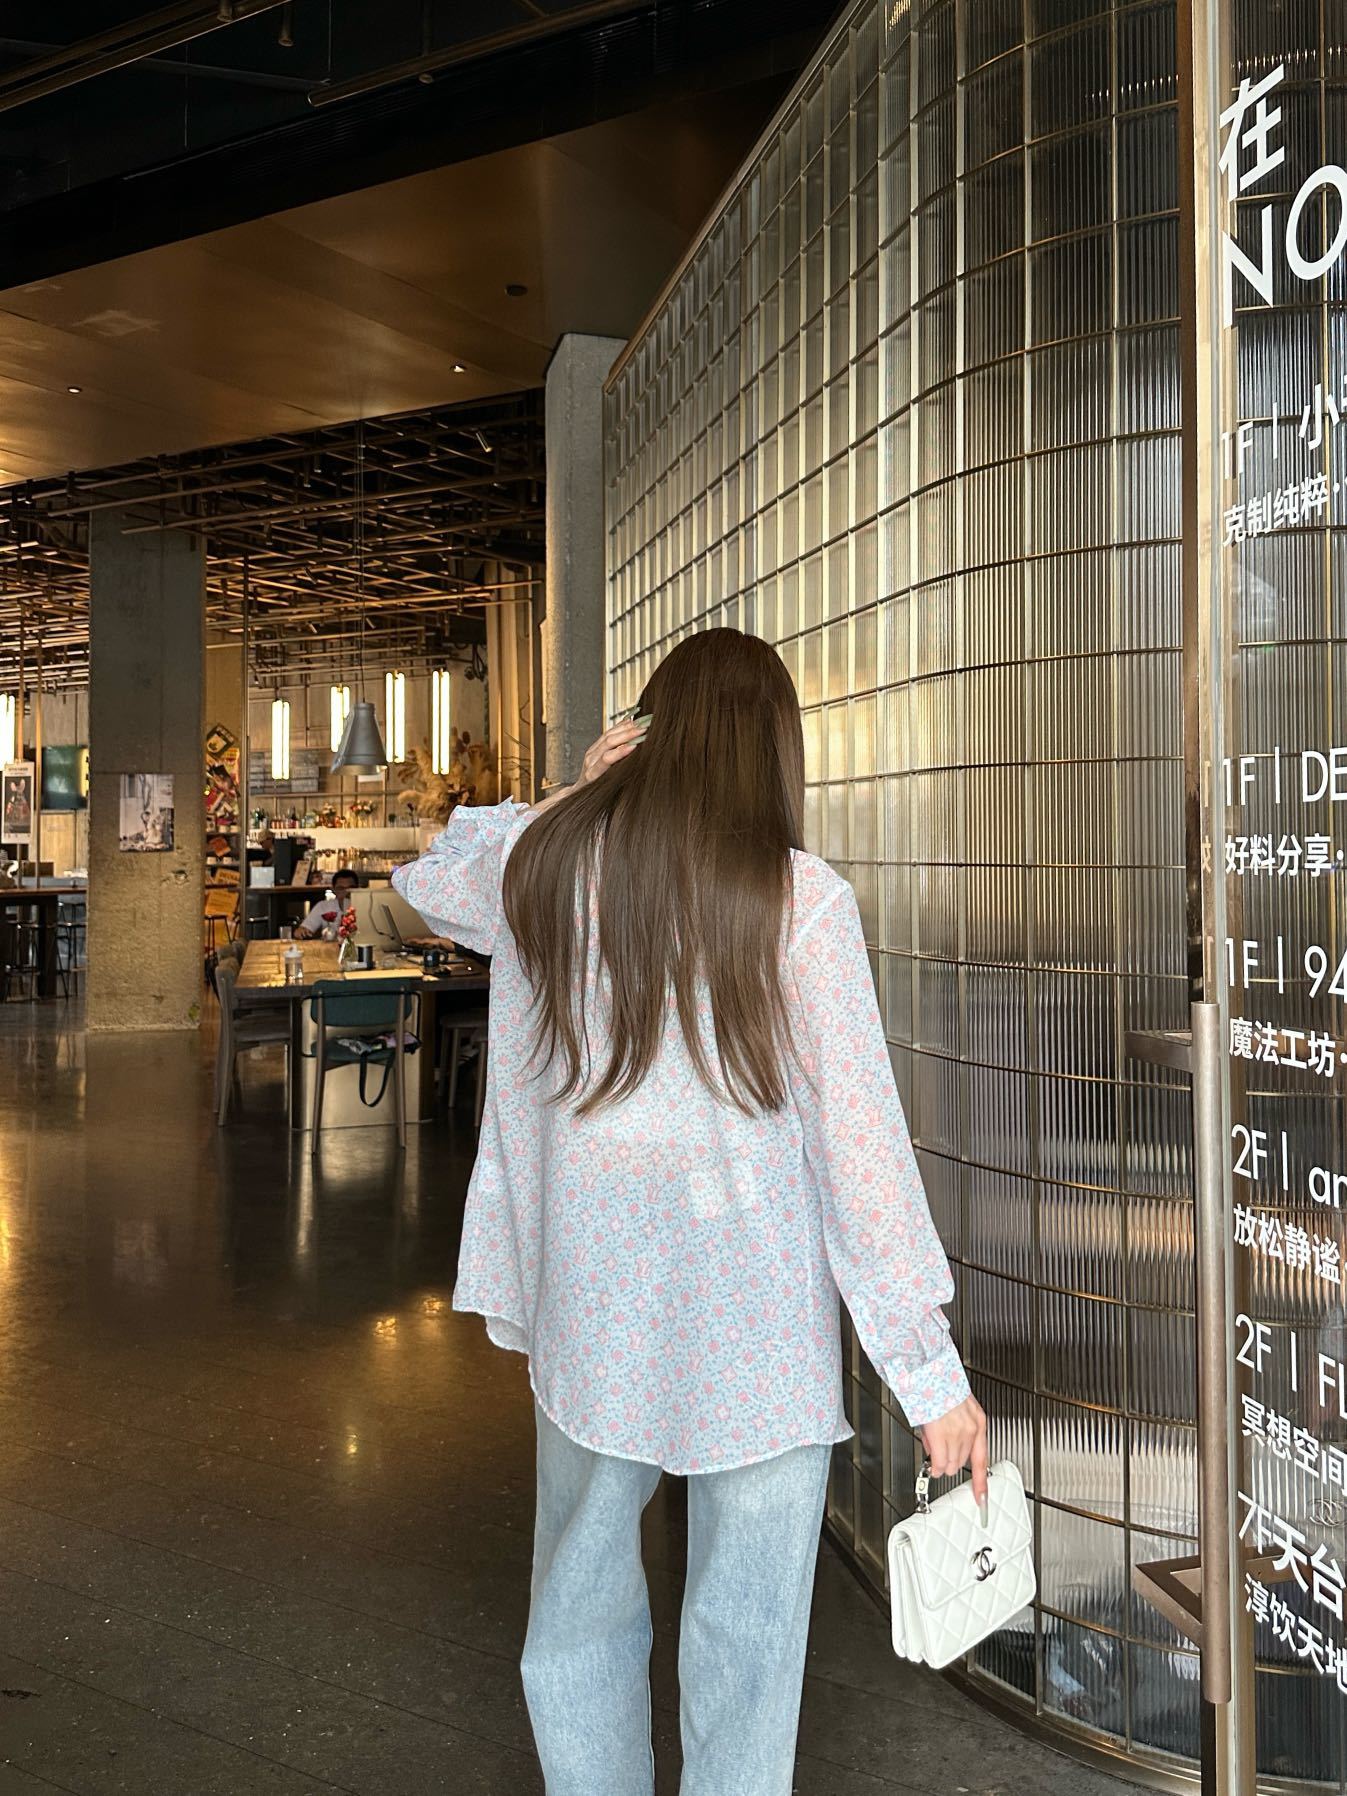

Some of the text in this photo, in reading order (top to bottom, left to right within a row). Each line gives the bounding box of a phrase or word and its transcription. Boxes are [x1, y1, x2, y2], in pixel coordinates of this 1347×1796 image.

[1218, 64, 1285, 202] 在
[1222, 421, 1254, 480] 1F
[1298, 375, 1347, 450] 小
[1223, 757, 1255, 807] 1F
[1225, 937, 1259, 989] 1F
[1231, 1124, 1268, 1181] 2F
[1235, 1313, 1272, 1374] 2F
[1241, 1393, 1347, 1497] 冥想空间
